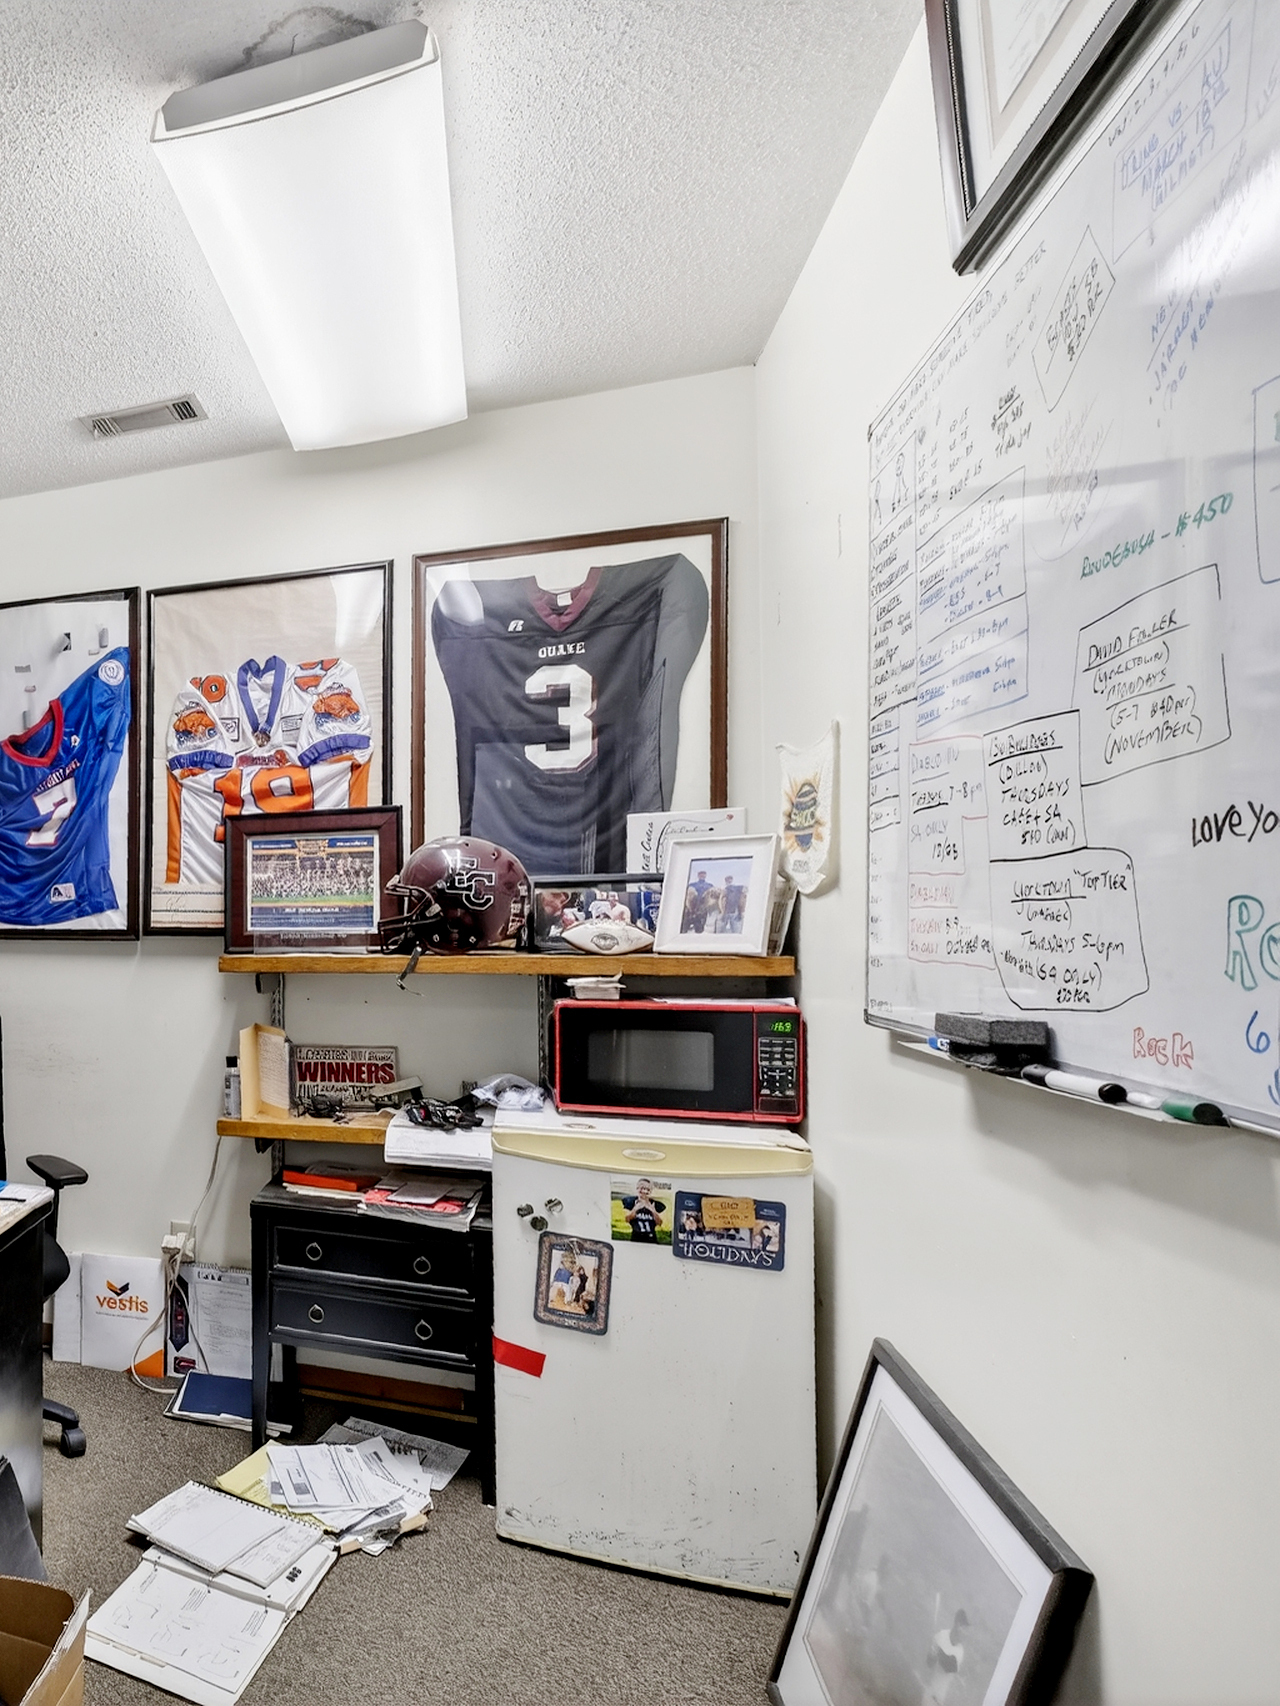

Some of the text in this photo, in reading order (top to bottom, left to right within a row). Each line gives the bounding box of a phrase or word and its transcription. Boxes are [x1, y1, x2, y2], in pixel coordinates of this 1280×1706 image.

[538, 641, 586, 658] QUAKE
[525, 664, 597, 774] 3
[296, 1061, 397, 1085] WINNERS
[96, 1295, 149, 1313] vestis
